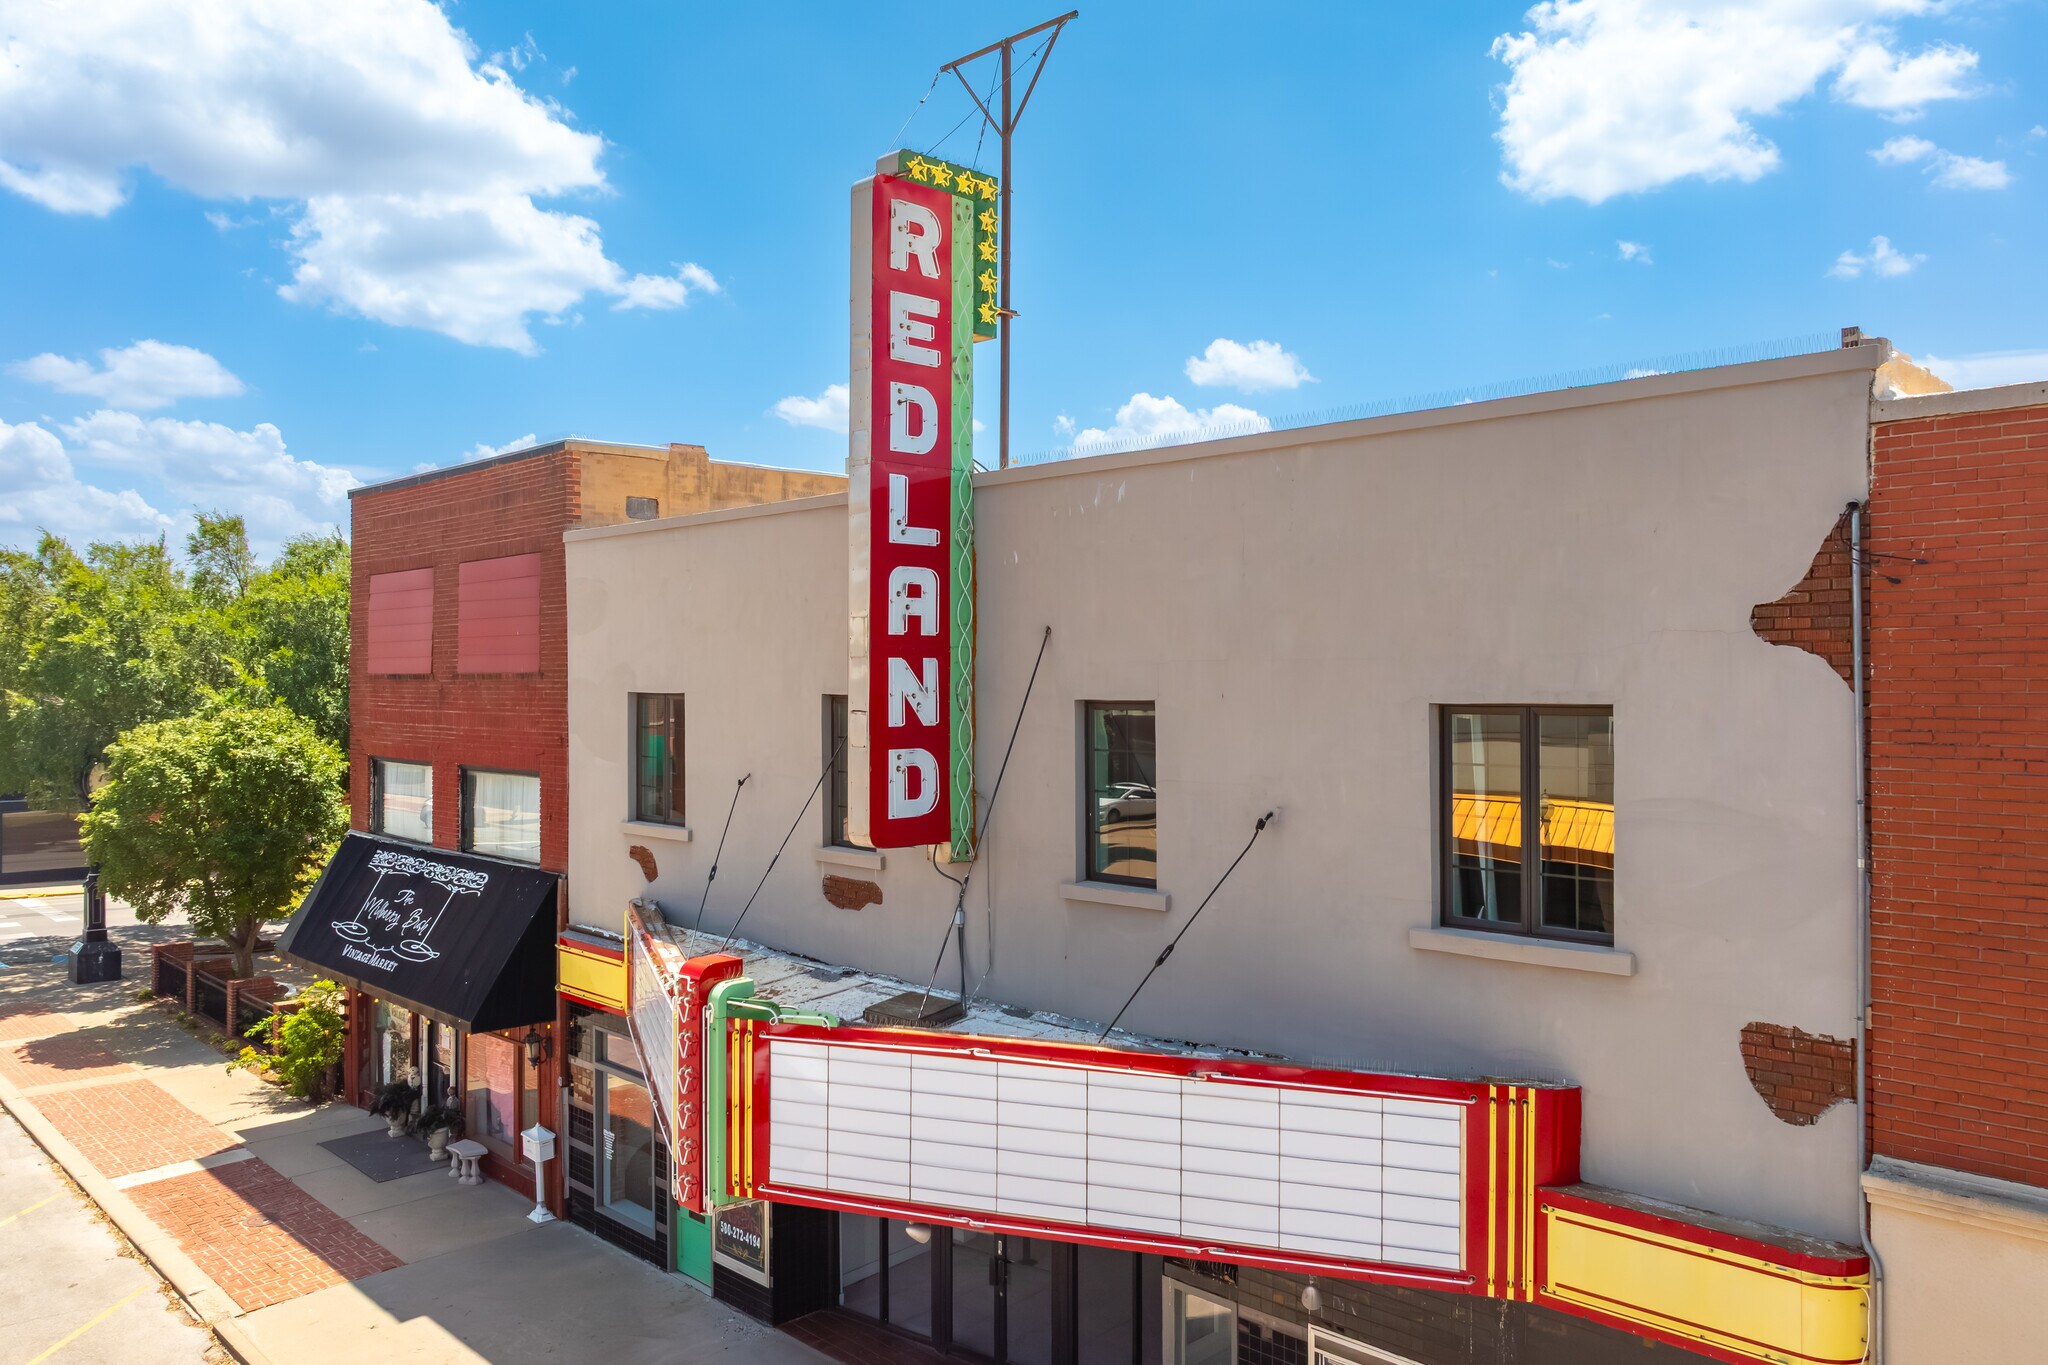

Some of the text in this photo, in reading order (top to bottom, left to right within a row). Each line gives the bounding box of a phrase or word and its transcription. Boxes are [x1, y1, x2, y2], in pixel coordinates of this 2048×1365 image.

[887, 198, 941, 821] REDLAND
[394, 890, 415, 906] The
[401, 909, 432, 935] Bush
[342, 944, 398, 972] VINTAGE MARKET
